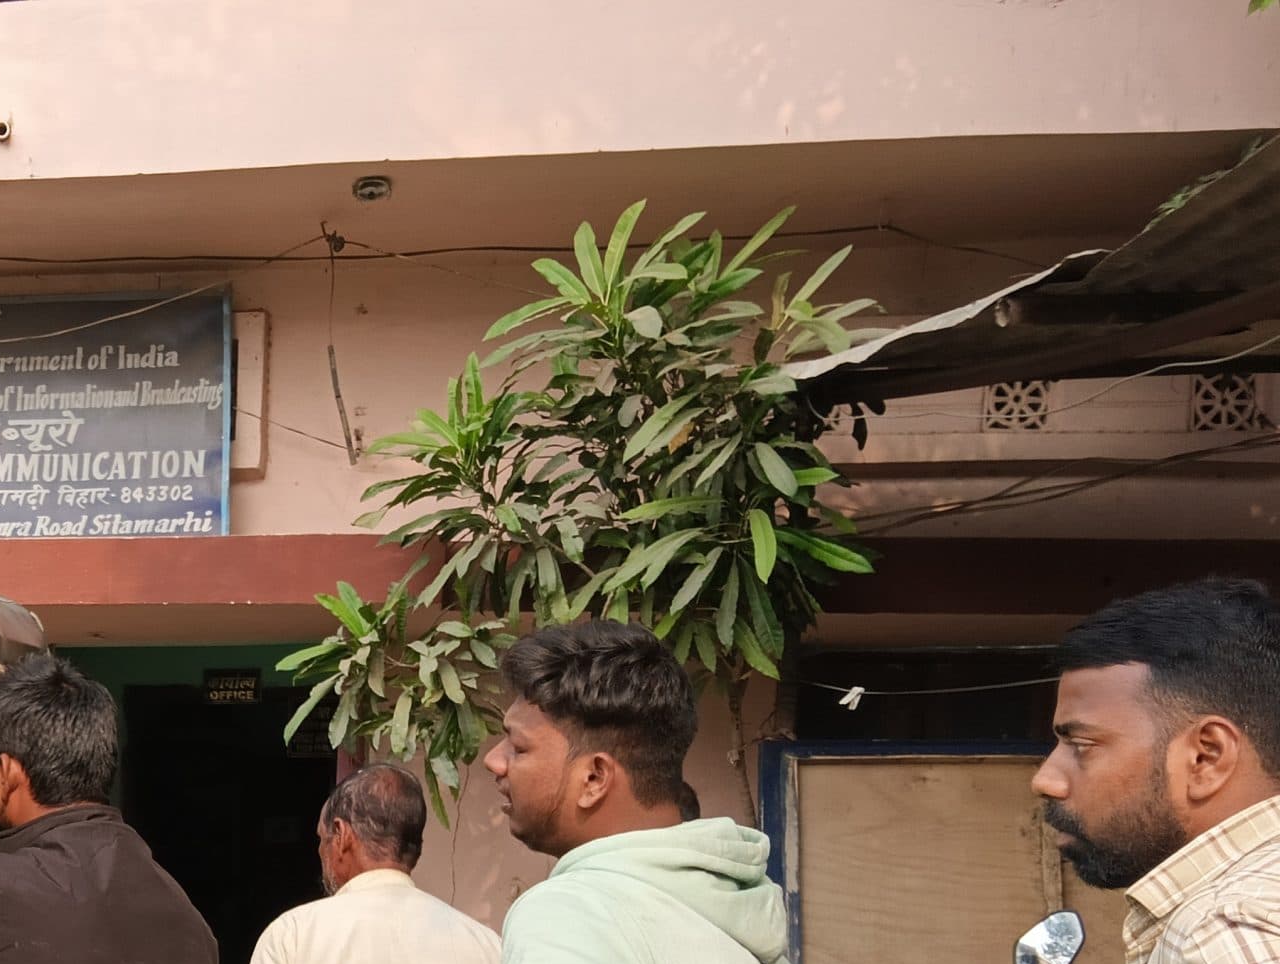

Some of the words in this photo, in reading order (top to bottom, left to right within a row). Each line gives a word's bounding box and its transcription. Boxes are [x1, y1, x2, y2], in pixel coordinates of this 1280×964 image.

[88, 345, 114, 371] of
[119, 344, 180, 370] India
[2, 410, 85, 452] ब्यूरो
[120, 484, 193, 504] 843302
[32, 514, 88, 536] Road
[89, 510, 213, 535] Sitamarhi
[209, 690, 255, 700] OFFICE
